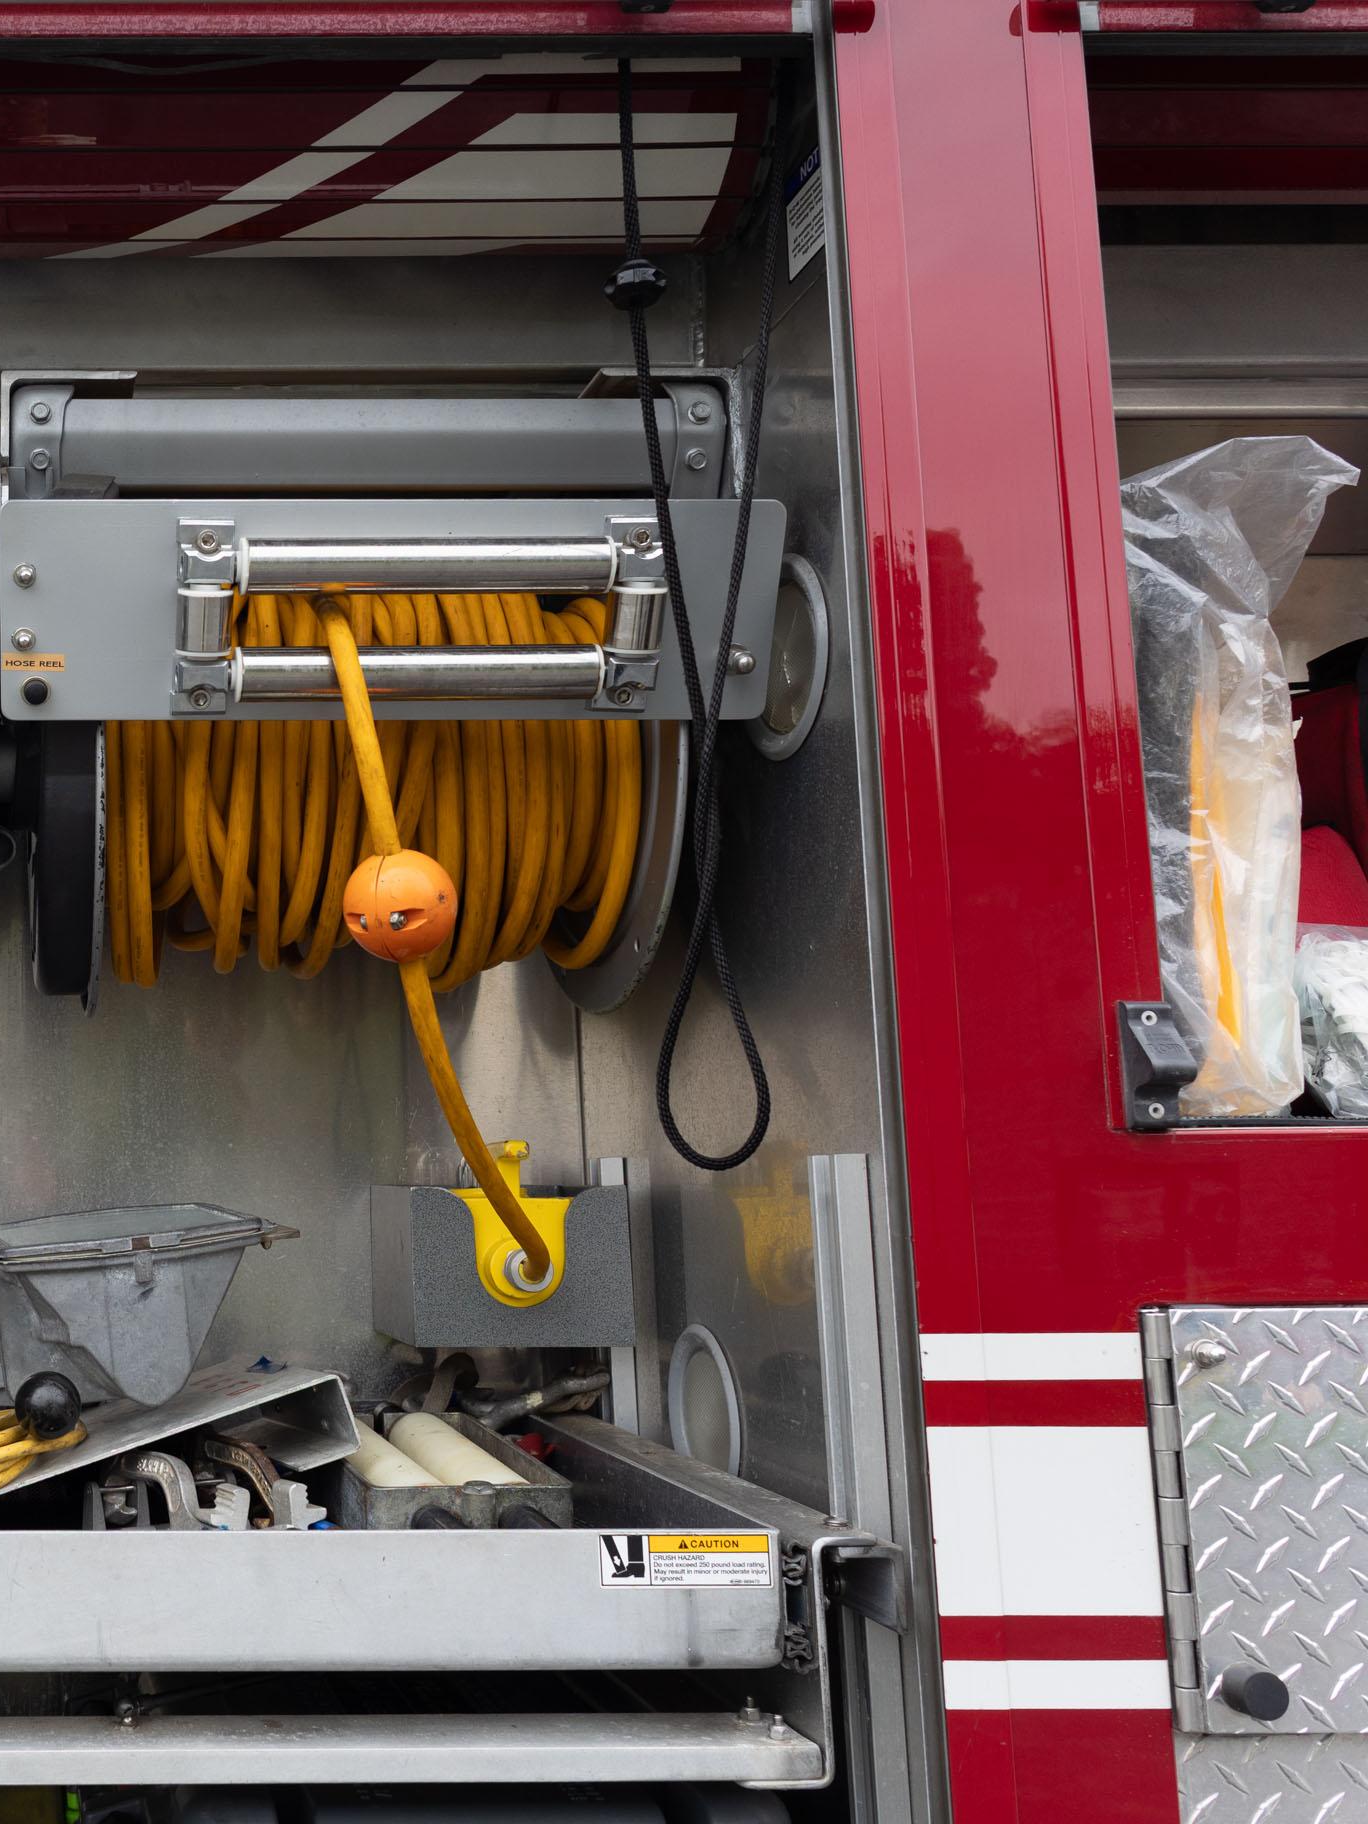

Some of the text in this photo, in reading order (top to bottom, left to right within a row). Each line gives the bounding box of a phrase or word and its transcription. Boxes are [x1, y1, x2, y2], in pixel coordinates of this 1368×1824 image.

[39, 660, 65, 668] REEL
[690, 1540, 739, 1549] CAUTION
[659, 1575, 683, 1583] ignored.
